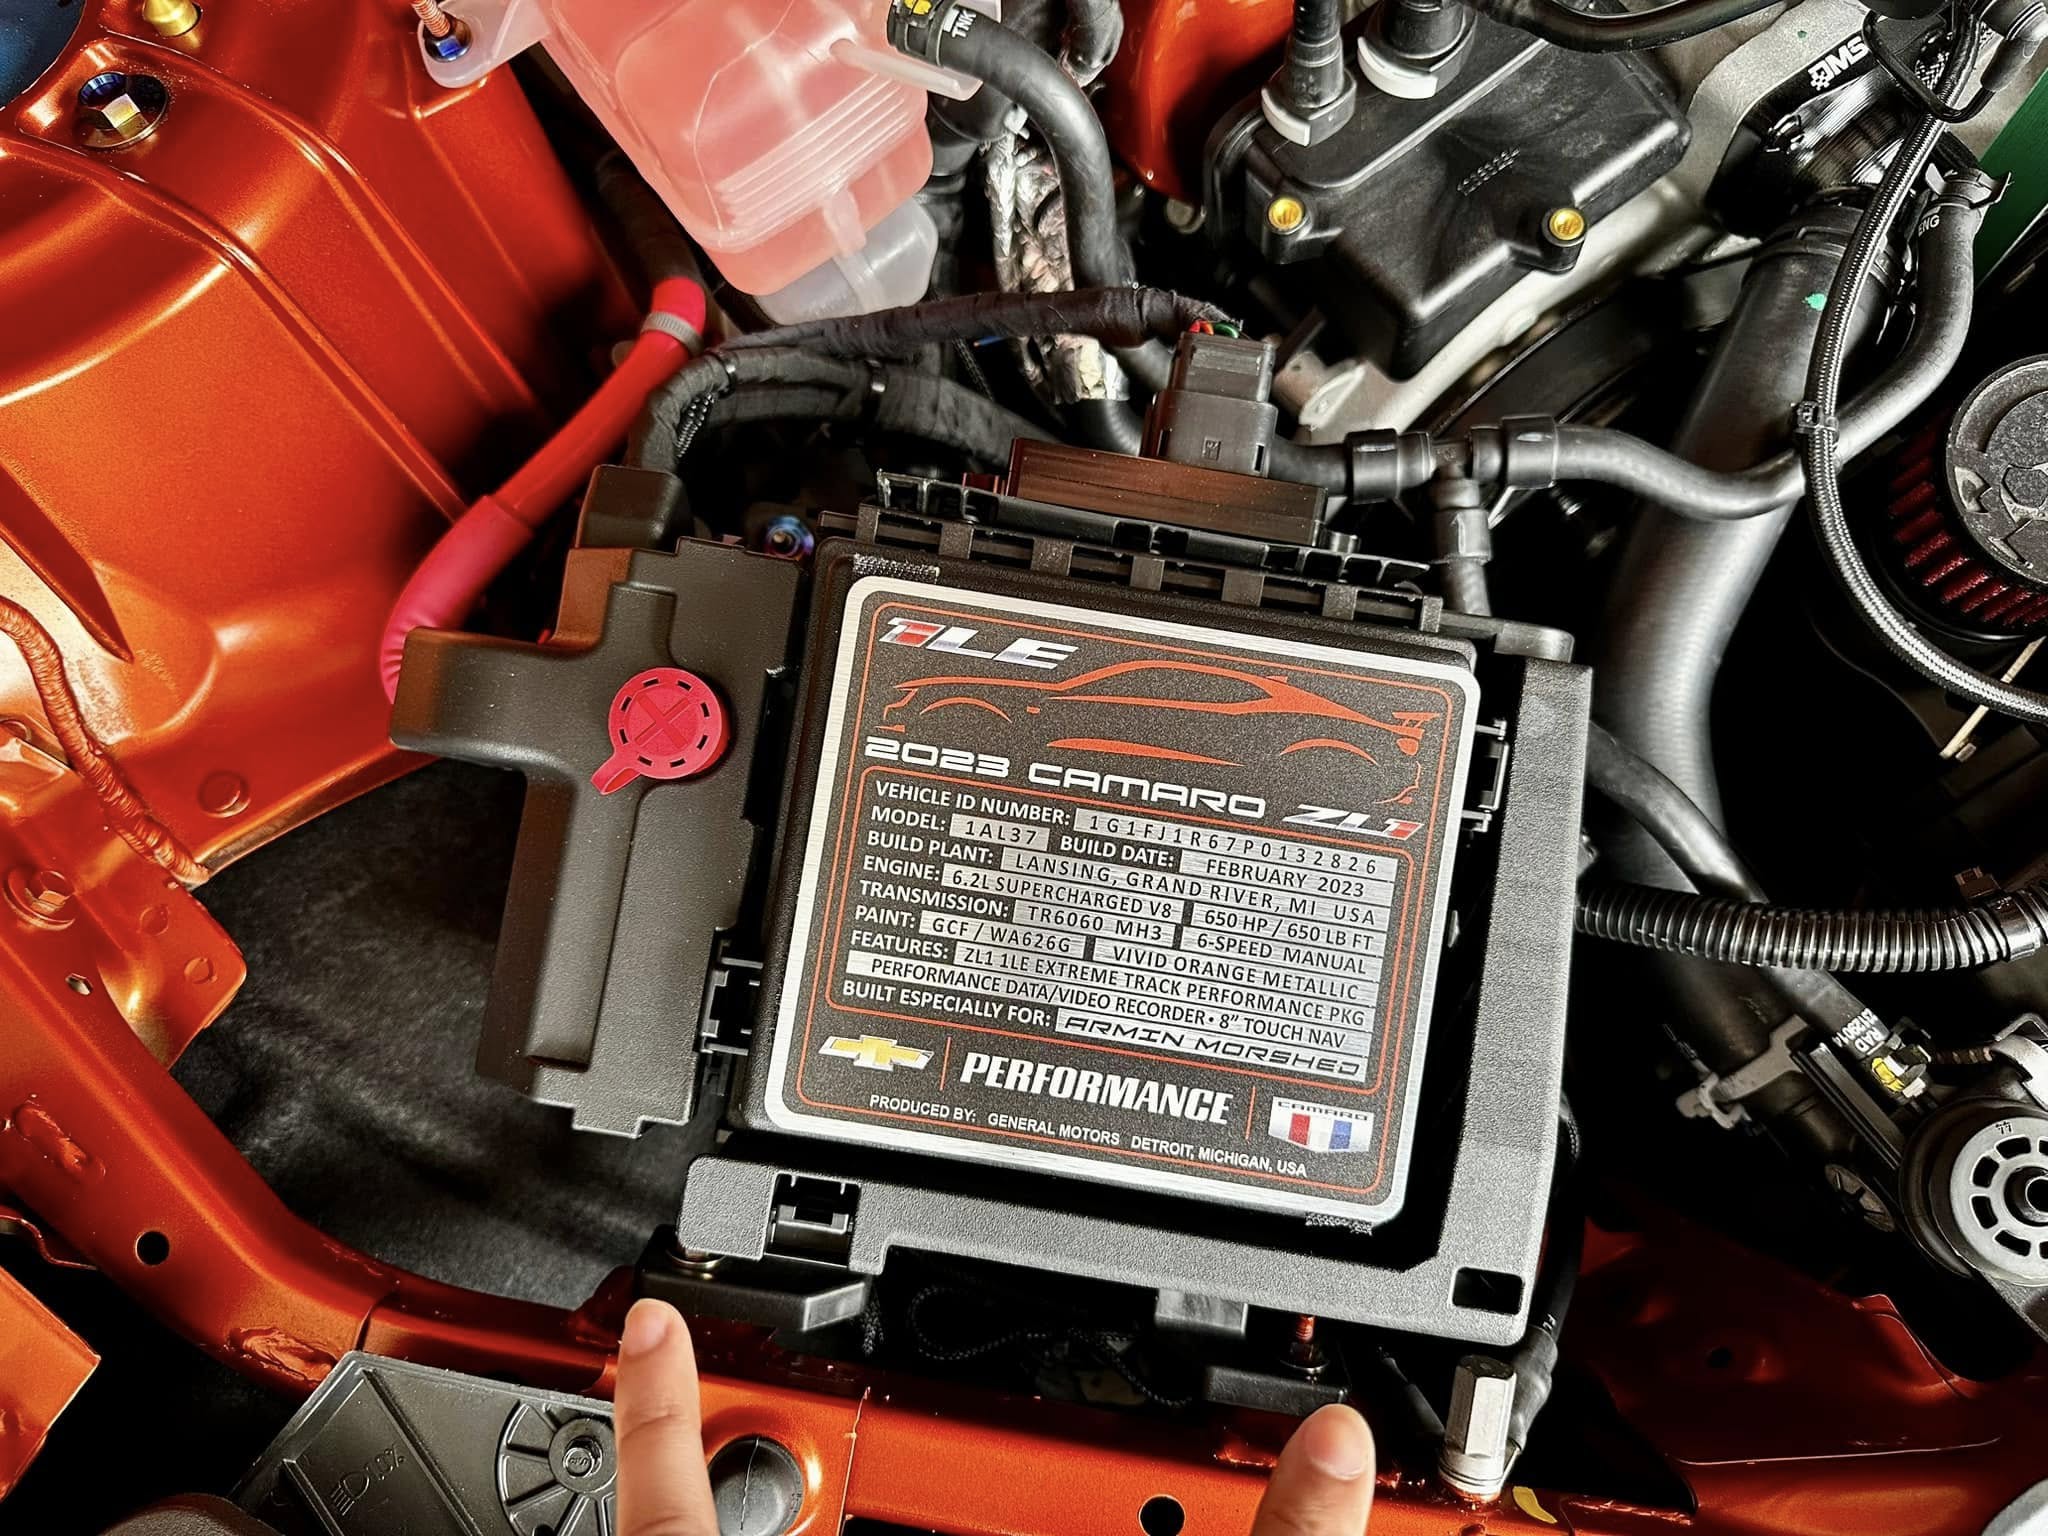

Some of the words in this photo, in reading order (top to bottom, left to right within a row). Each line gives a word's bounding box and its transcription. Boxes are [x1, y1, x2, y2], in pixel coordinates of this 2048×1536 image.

[952, 9, 977, 38] TNK
[863, 735, 1011, 778] 2023
[1027, 761, 1267, 819] CAMARO
[1281, 803, 1424, 842] ZL1
[875, 779, 952, 807] VEHICLE
[955, 793, 976, 810] ID
[979, 797, 1071, 826] NUMBER:
[866, 829, 924, 853] BUILD
[927, 839, 994, 865] PLANT:
[1015, 852, 1117, 886] LANSING,
[1125, 870, 1202, 897] GRAND
[1209, 884, 1280, 913] RIVER,
[1288, 897, 1316, 916] MI
[1333, 904, 1375, 926] USA
[870, 804, 946, 831] MODEL:
[964, 820, 1037, 845] 1AL37
[1059, 834, 1117, 858] BUILD
[1120, 844, 1174, 868] DATE:
[1205, 858, 1308, 889] FEBRUARY
[1316, 876, 1364, 898] 2023
[859, 878, 1009, 918] TRANSMISSION:
[1027, 904, 1104, 932] TR6060
[1114, 919, 1162, 941] MH3
[1196, 932, 1273, 959] 6-SPEED
[1282, 946, 1366, 975] MANUAL
[862, 854, 940, 882] ENGINE:
[952, 869, 990, 890] 6.2L
[994, 876, 1143, 914] SUPERCHARGED
[1149, 900, 1172, 919] V8
[1204, 909, 1238, 928] 650
[1242, 914, 1268, 933] HP
[1270, 918, 1284, 938] /
[1286, 922, 1321, 942] 650
[1325, 928, 1347, 946] LB
[1351, 932, 1374, 950] FT
[849, 929, 949, 960] FEATURES:
[963, 946, 993, 966] ZL1
[999, 952, 1030, 972] 1LE
[1034, 957, 1119, 986] EXTREME
[1123, 972, 1182, 996] TRACK
[1186, 982, 1324, 1020] PERFORMANCE
[1328, 1005, 1365, 1026] PKG
[854, 904, 916, 929] PAINT:
[931, 917, 969, 937] GCF
[972, 921, 985, 942] /
[990, 925, 1071, 953] WA626G
[1113, 945, 1167, 969] VIVID
[1173, 955, 1257, 984] ORANGE
[1262, 970, 1358, 1000] METALLIC
[842, 979, 897, 1003] BUILT
[898, 987, 1004, 1019] ESPECIALLY
[1006, 1005, 1051, 1027] FOR:
[1064, 1015, 1185, 1047] ARMIN
[1193, 1037, 1360, 1076] MORSHED
[871, 957, 1002, 993] PERFORMANCE
[1005, 978, 1111, 1010] DATA/VIDEO
[1243, 1016, 1304, 1042] TOUCH
[1307, 1027, 1346, 1049] NAV
[1855, 1026, 1881, 1053] RAD
[868, 1093, 950, 1119] PRODUCED
[952, 1106, 977, 1123] BY:
[987, 1112, 1053, 1136] GENERAL
[1058, 1123, 1121, 1146] MOTORS
[1130, 1134, 1195, 1161] DETROIT,
[1197, 1145, 1273, 1173] MICHIGAN,
[1276, 1159, 1308, 1178] USA
[959, 1051, 1234, 1126] PERFORMANCE
[1277, 1100, 1368, 1121] CAMARO
